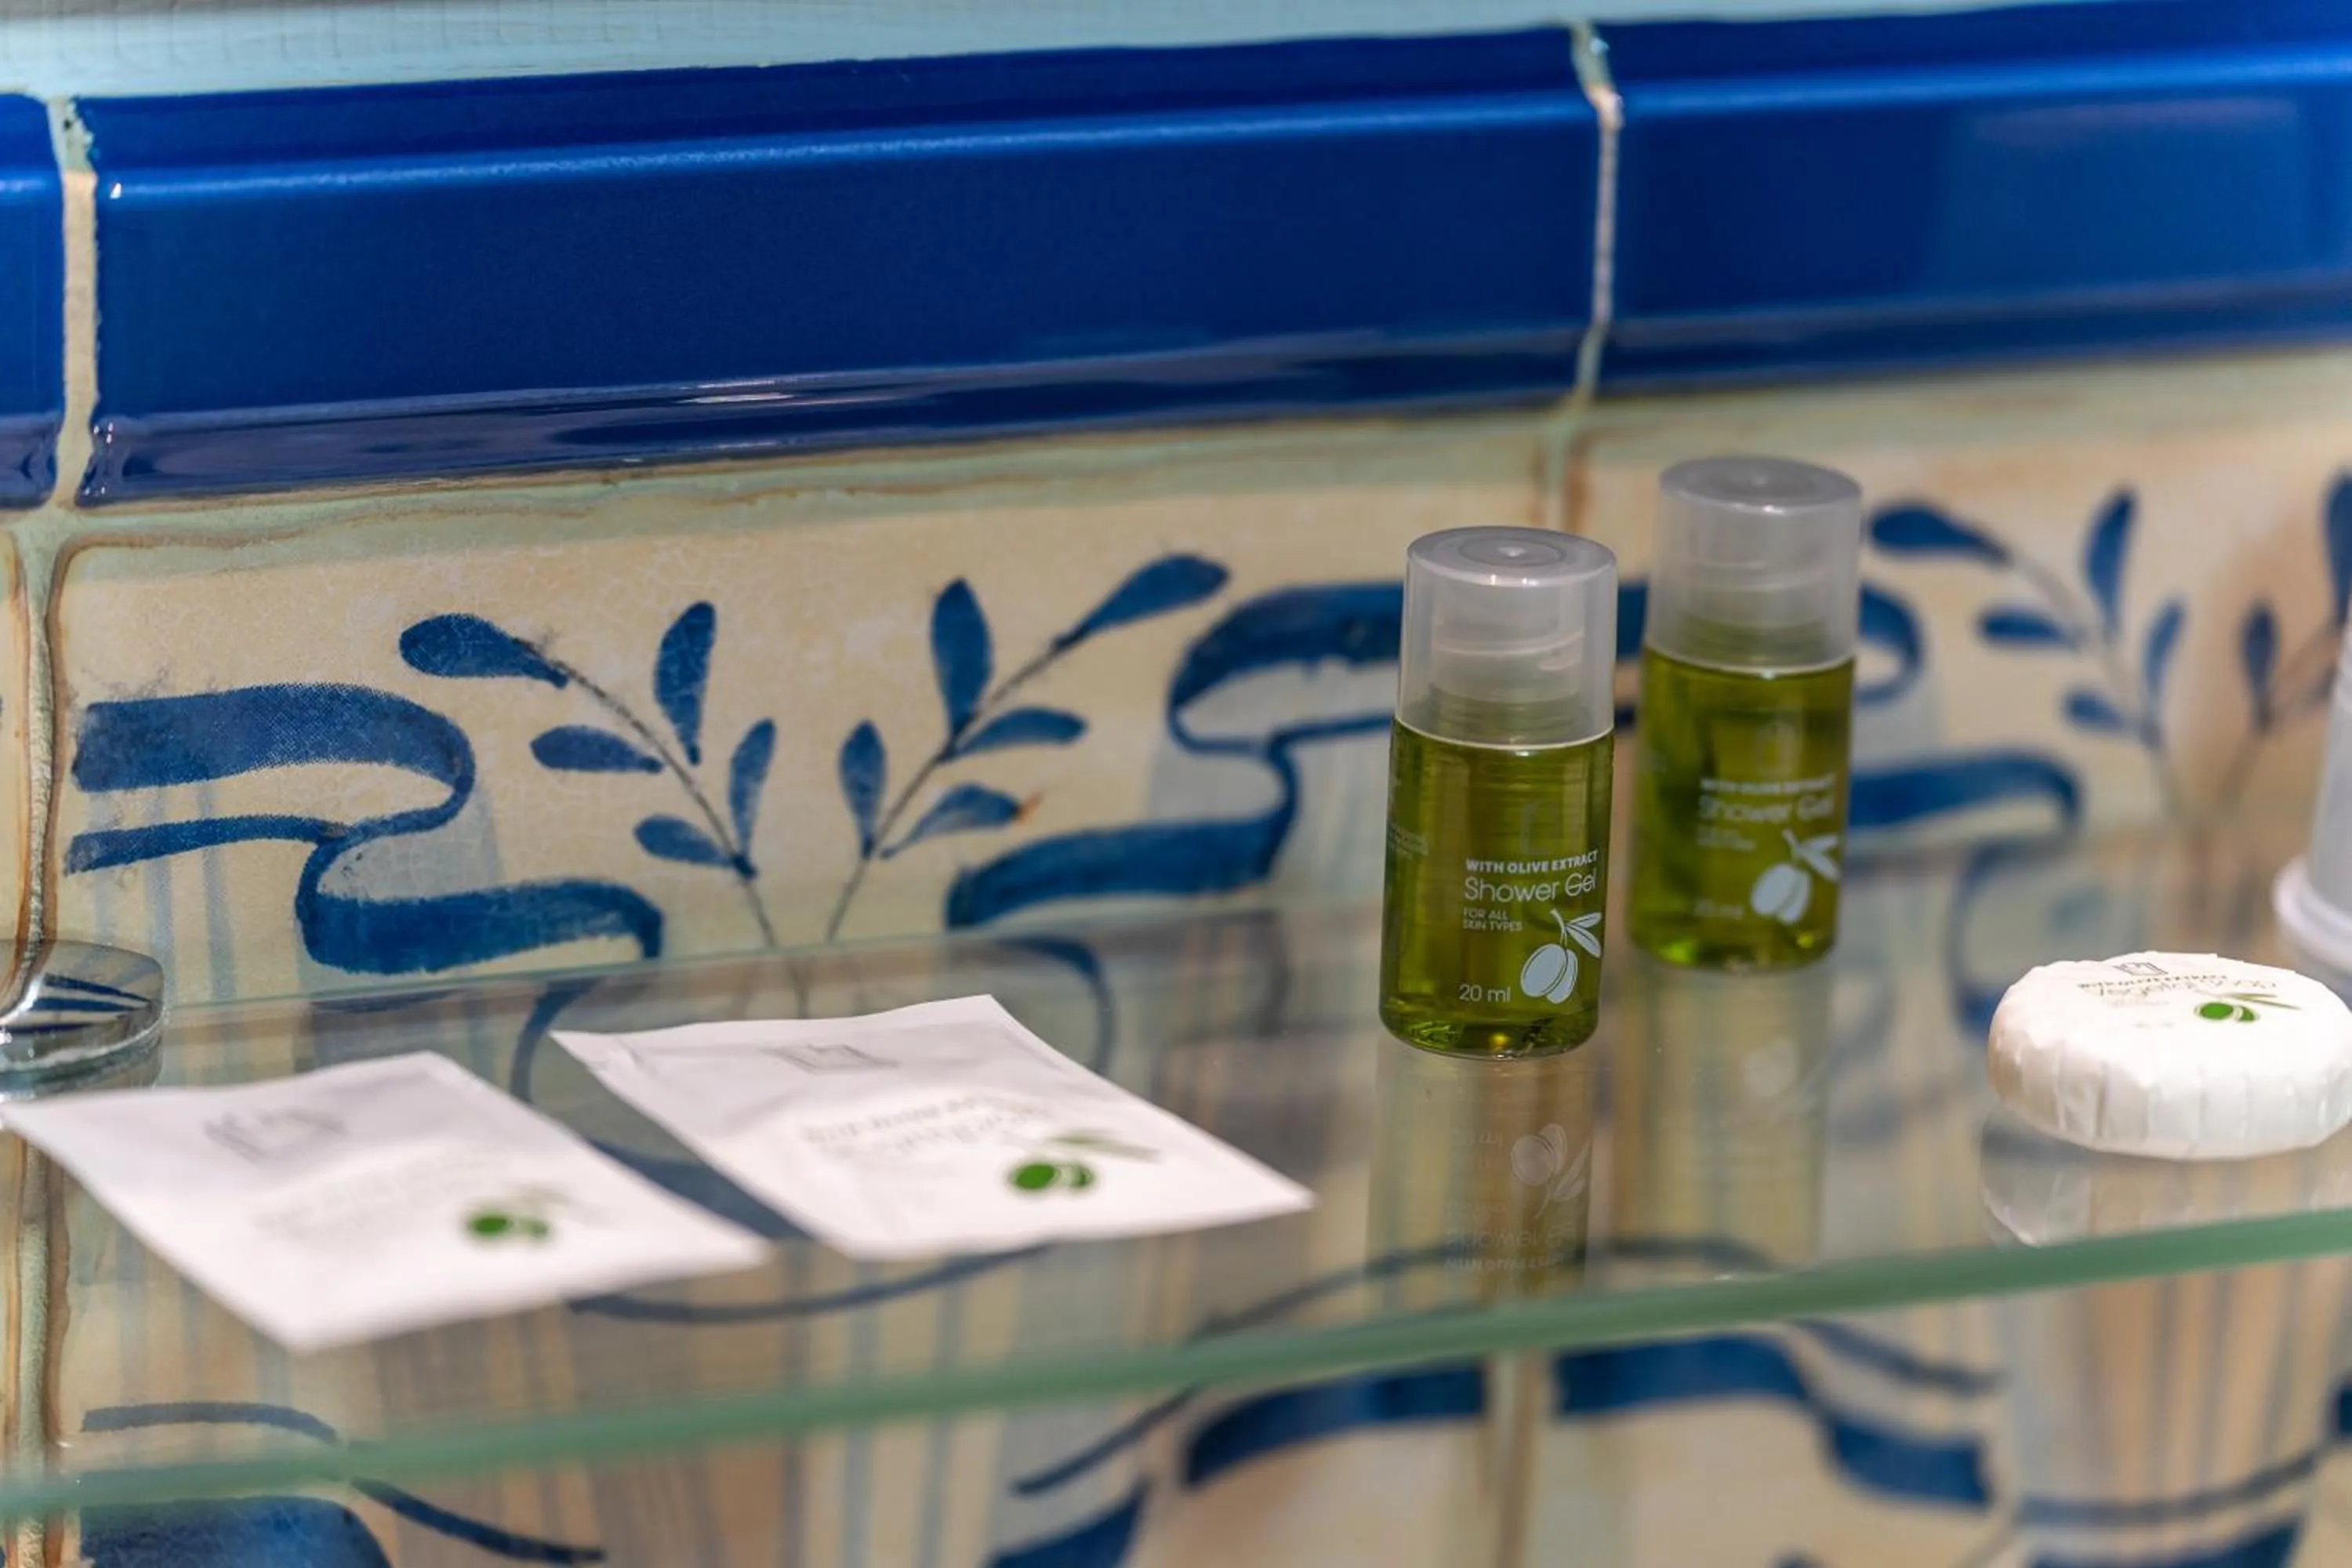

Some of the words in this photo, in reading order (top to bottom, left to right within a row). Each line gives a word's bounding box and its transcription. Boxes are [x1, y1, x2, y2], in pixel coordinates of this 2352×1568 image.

[1465, 858, 1504, 873] WITH
[1507, 862, 1549, 874] OLIVE
[1552, 850, 1598, 871] EXTRACT
[1465, 877, 1559, 902] Shower
[1564, 868, 1596, 897] Gel
[1463, 907, 1486, 919] FOR
[1488, 909, 1508, 920] ALL
[1490, 920, 1523, 932] TYPES
[1459, 984, 1482, 1001] 20
[1487, 986, 1511, 1002] ml
